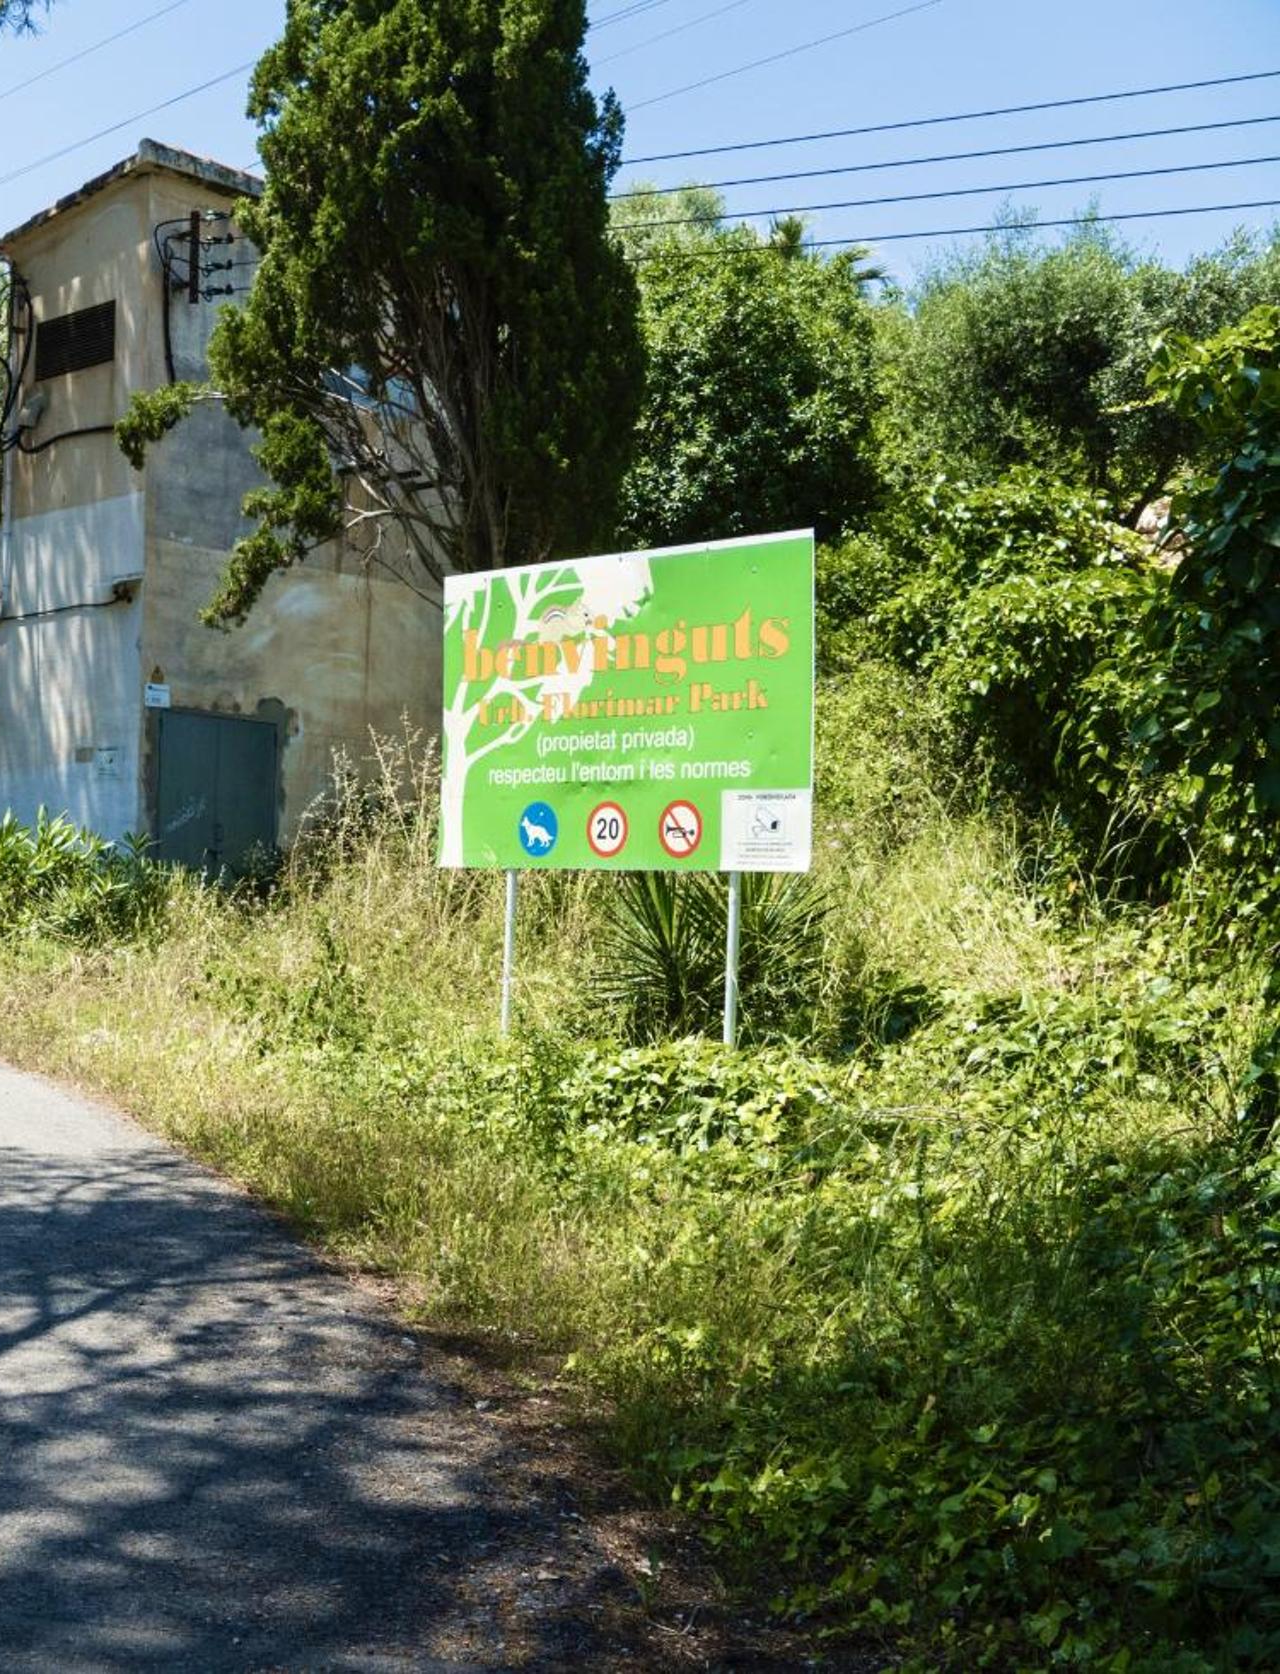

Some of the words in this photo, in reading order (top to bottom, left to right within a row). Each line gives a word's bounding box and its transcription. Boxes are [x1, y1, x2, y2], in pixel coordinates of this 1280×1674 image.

[463, 602, 791, 686] benvinguts
[541, 688, 680, 722] Florimar
[688, 678, 769, 714] Park
[536, 729, 617, 757] (propietat
[622, 723, 695, 753] privada)
[489, 765, 566, 789] respecteu
[650, 760, 676, 780] les
[680, 760, 752, 779] normes
[596, 816, 620, 841] 20
